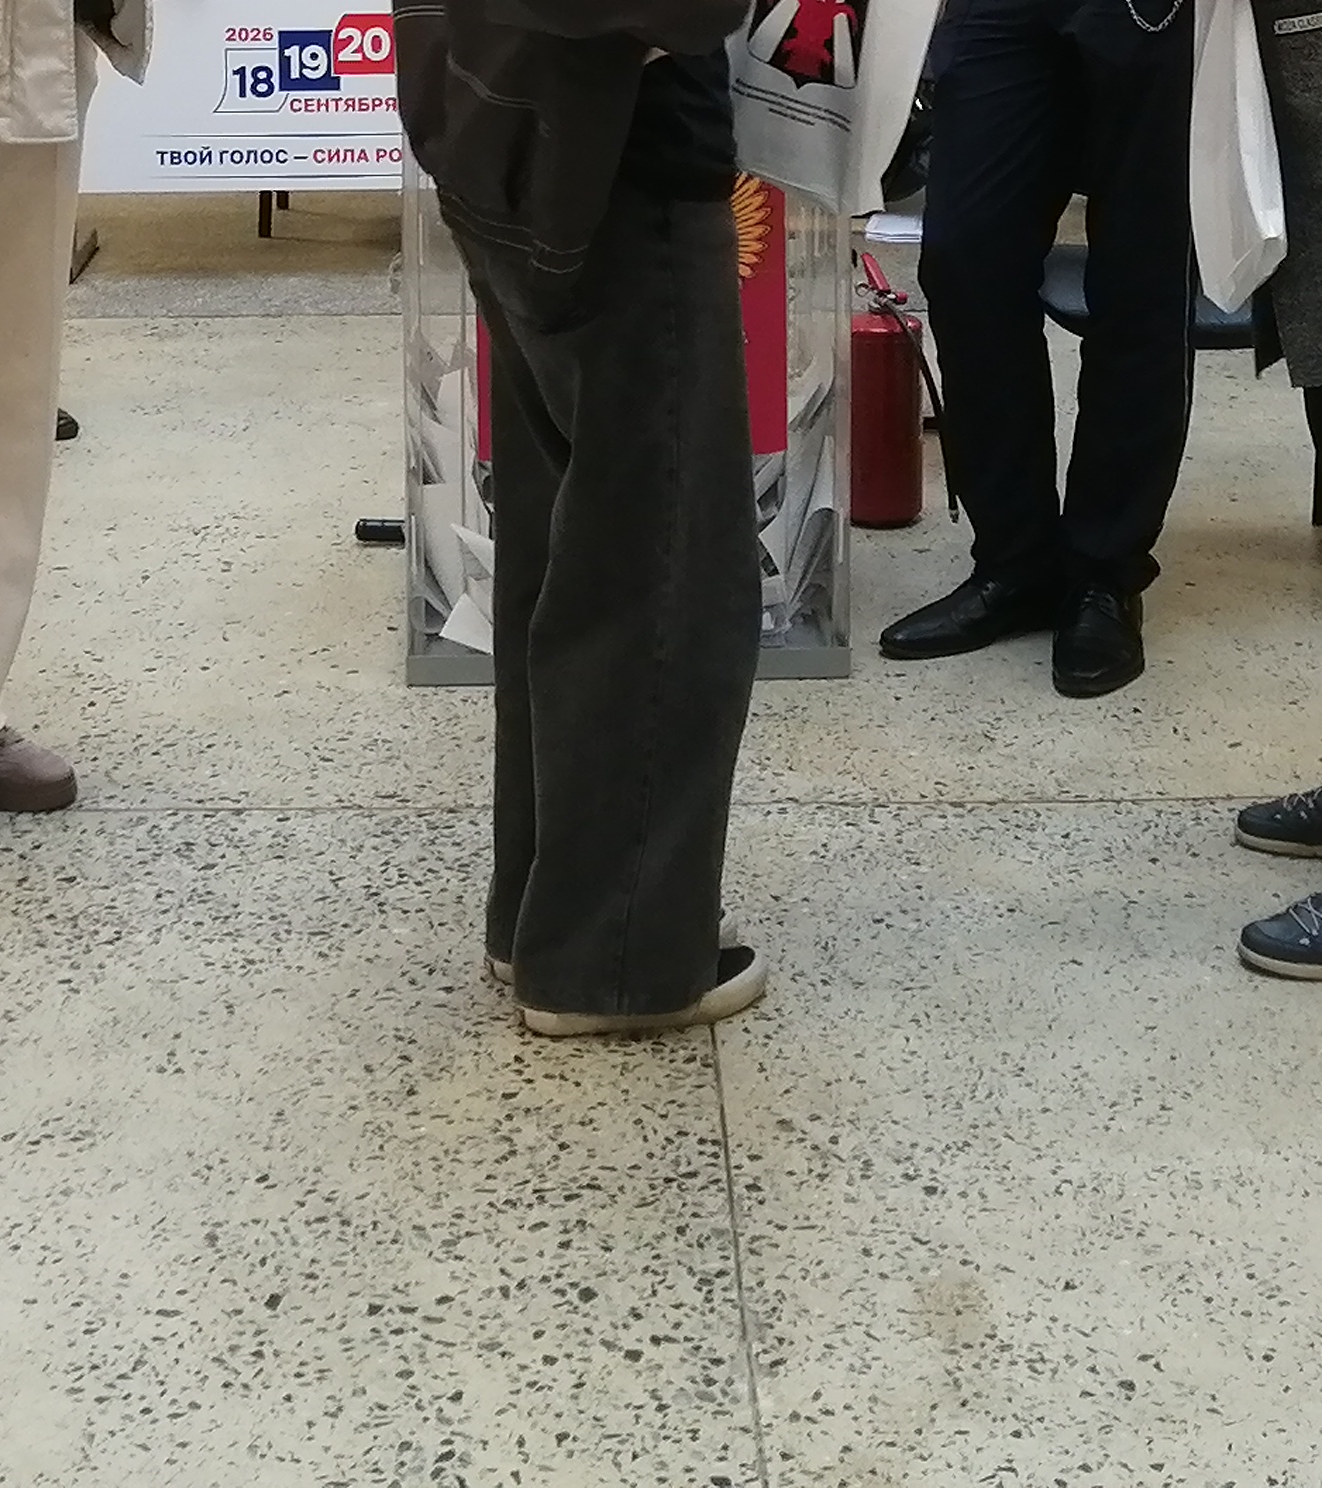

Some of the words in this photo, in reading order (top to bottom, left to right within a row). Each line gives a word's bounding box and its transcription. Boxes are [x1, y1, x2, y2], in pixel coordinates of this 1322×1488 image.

[224, 27, 274, 42] 2026
[232, 65, 275, 98] 18
[283, 44, 328, 80] 19
[337, 27, 391, 62] 20
[289, 97, 398, 113] СЕНТЯБРЯ
[156, 146, 213, 166] ТВОЙ
[218, 148, 289, 165] ГОЛОС
[312, 147, 370, 165] СИЛА
